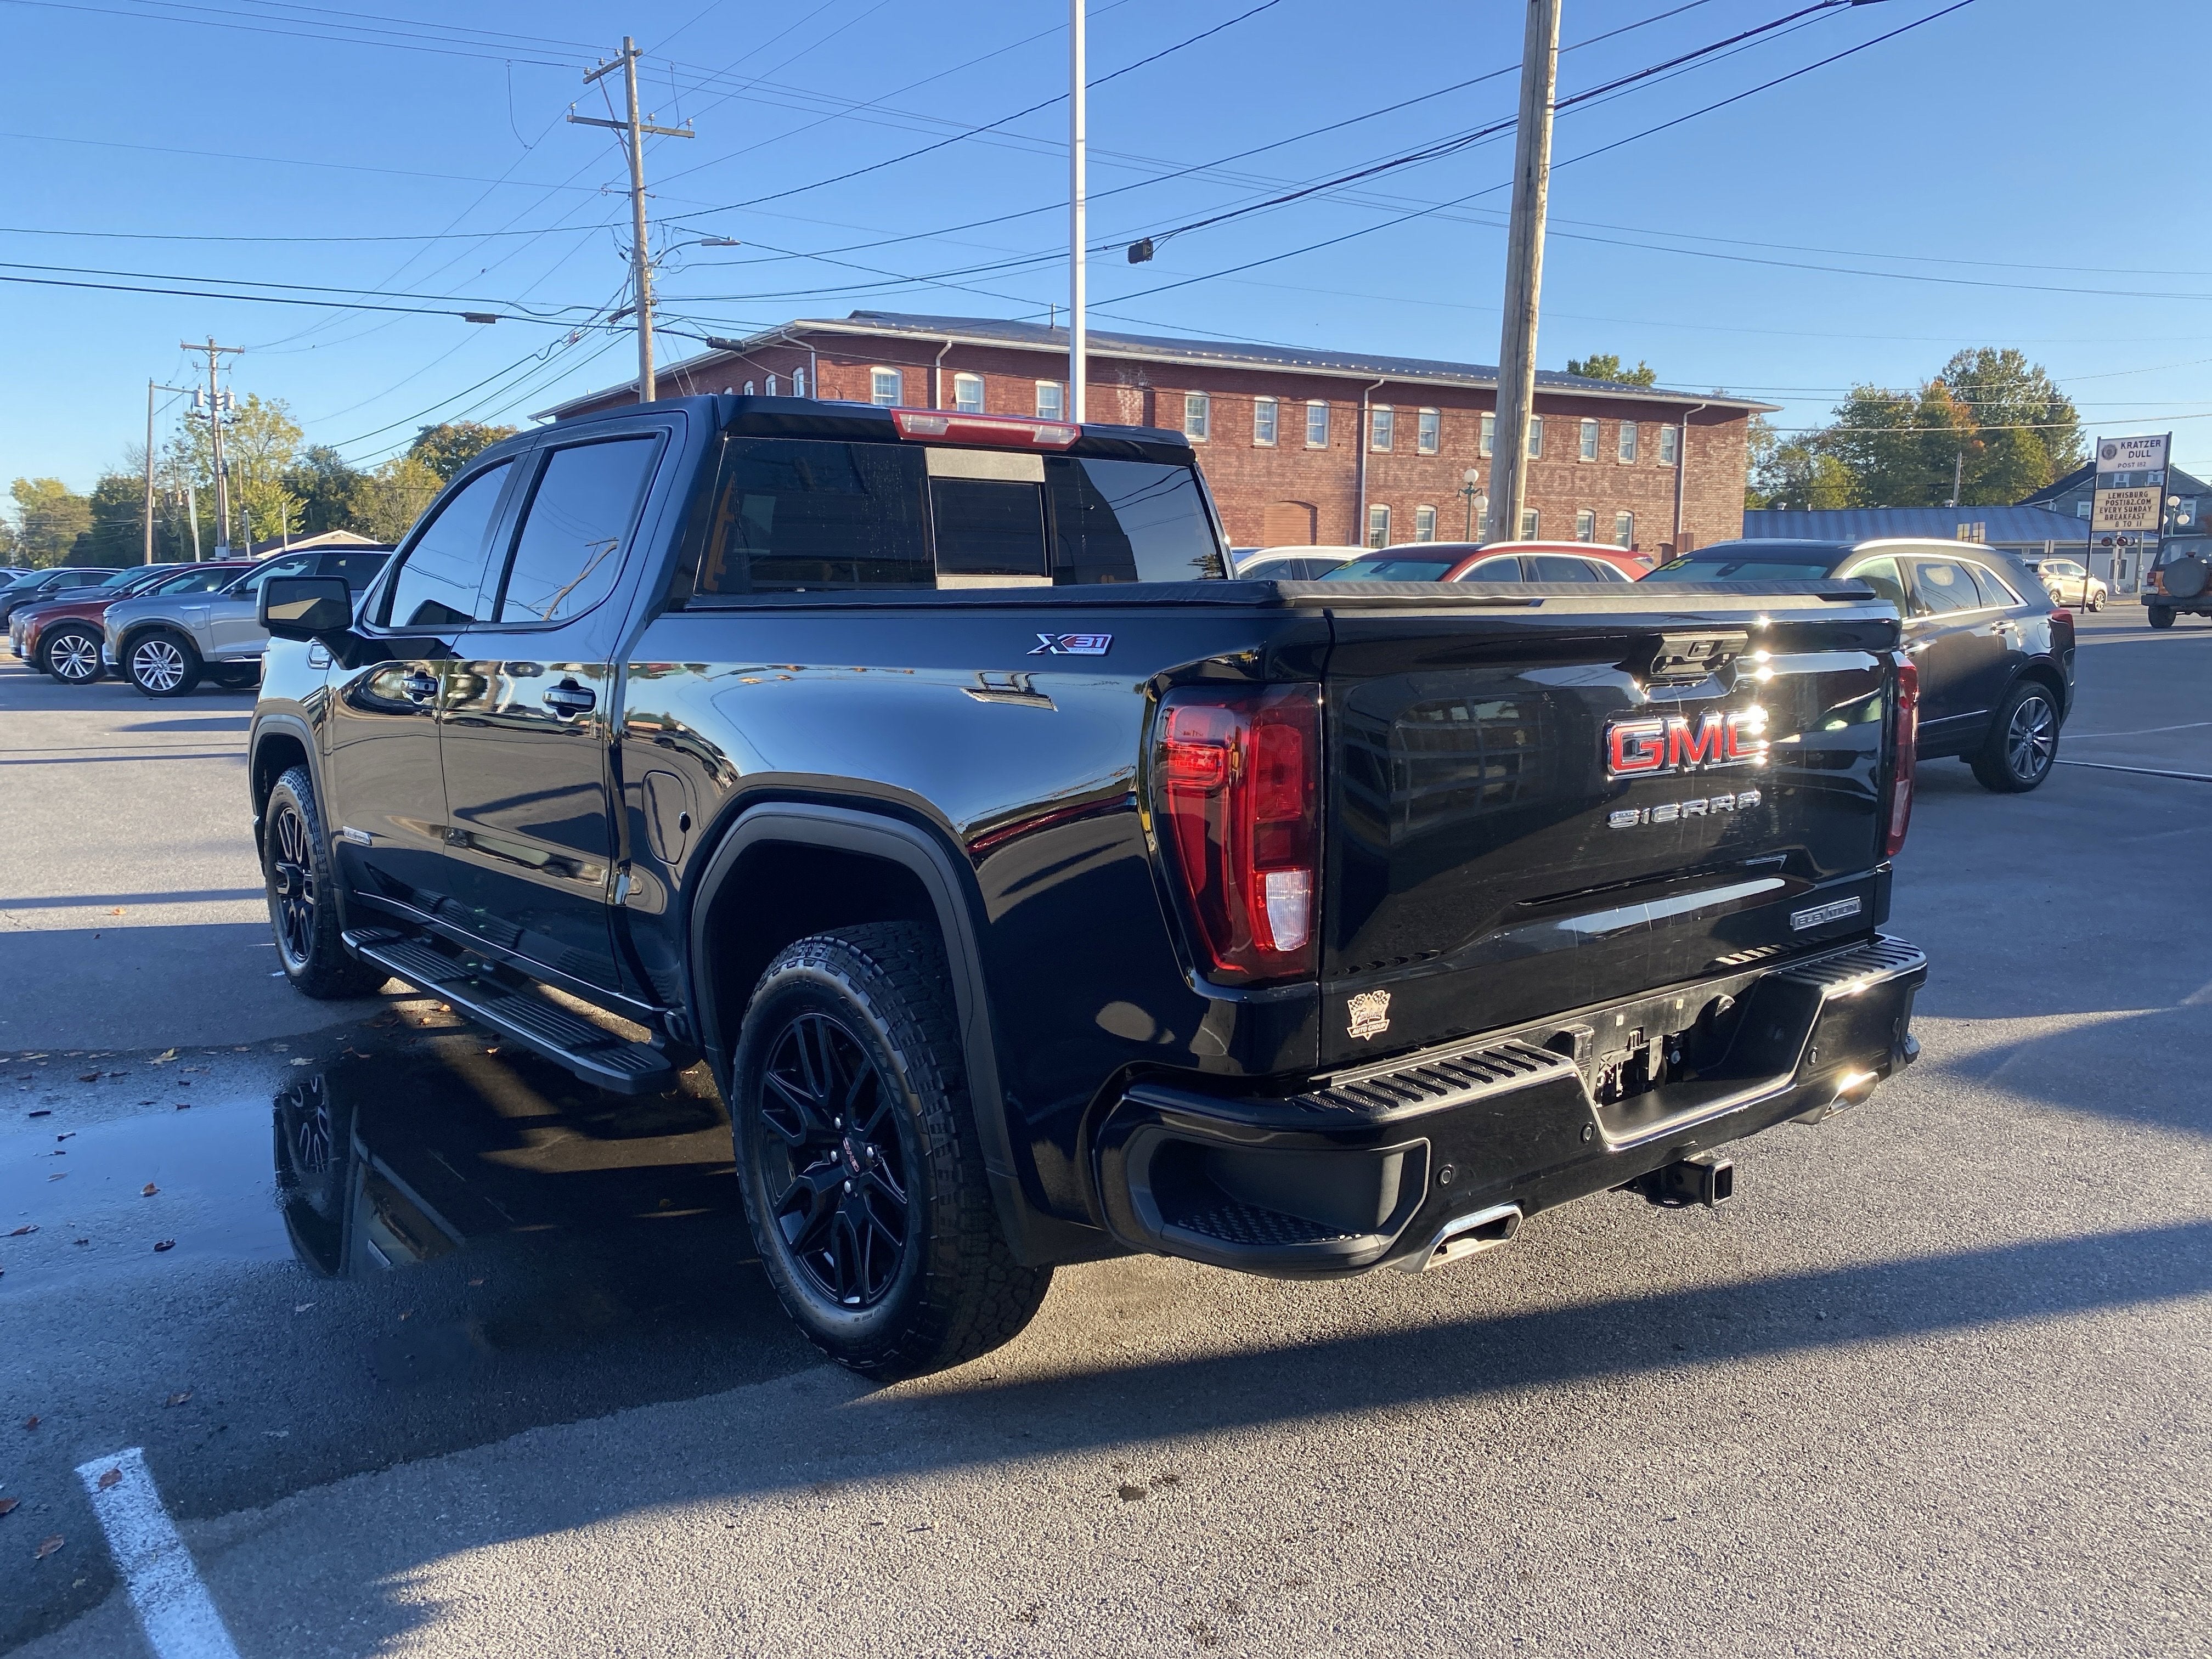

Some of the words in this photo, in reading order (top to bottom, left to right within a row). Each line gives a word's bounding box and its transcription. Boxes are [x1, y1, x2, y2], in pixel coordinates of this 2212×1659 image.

[2120, 439, 2161, 449] KRATZER
[2129, 450, 2151, 458] DULL
[1606, 706, 1769, 778] GMC
[1607, 789, 1762, 829] SIERRA
[1352, 1026, 1367, 1035] AUTO
[1368, 1022, 1386, 1031] GROUP
